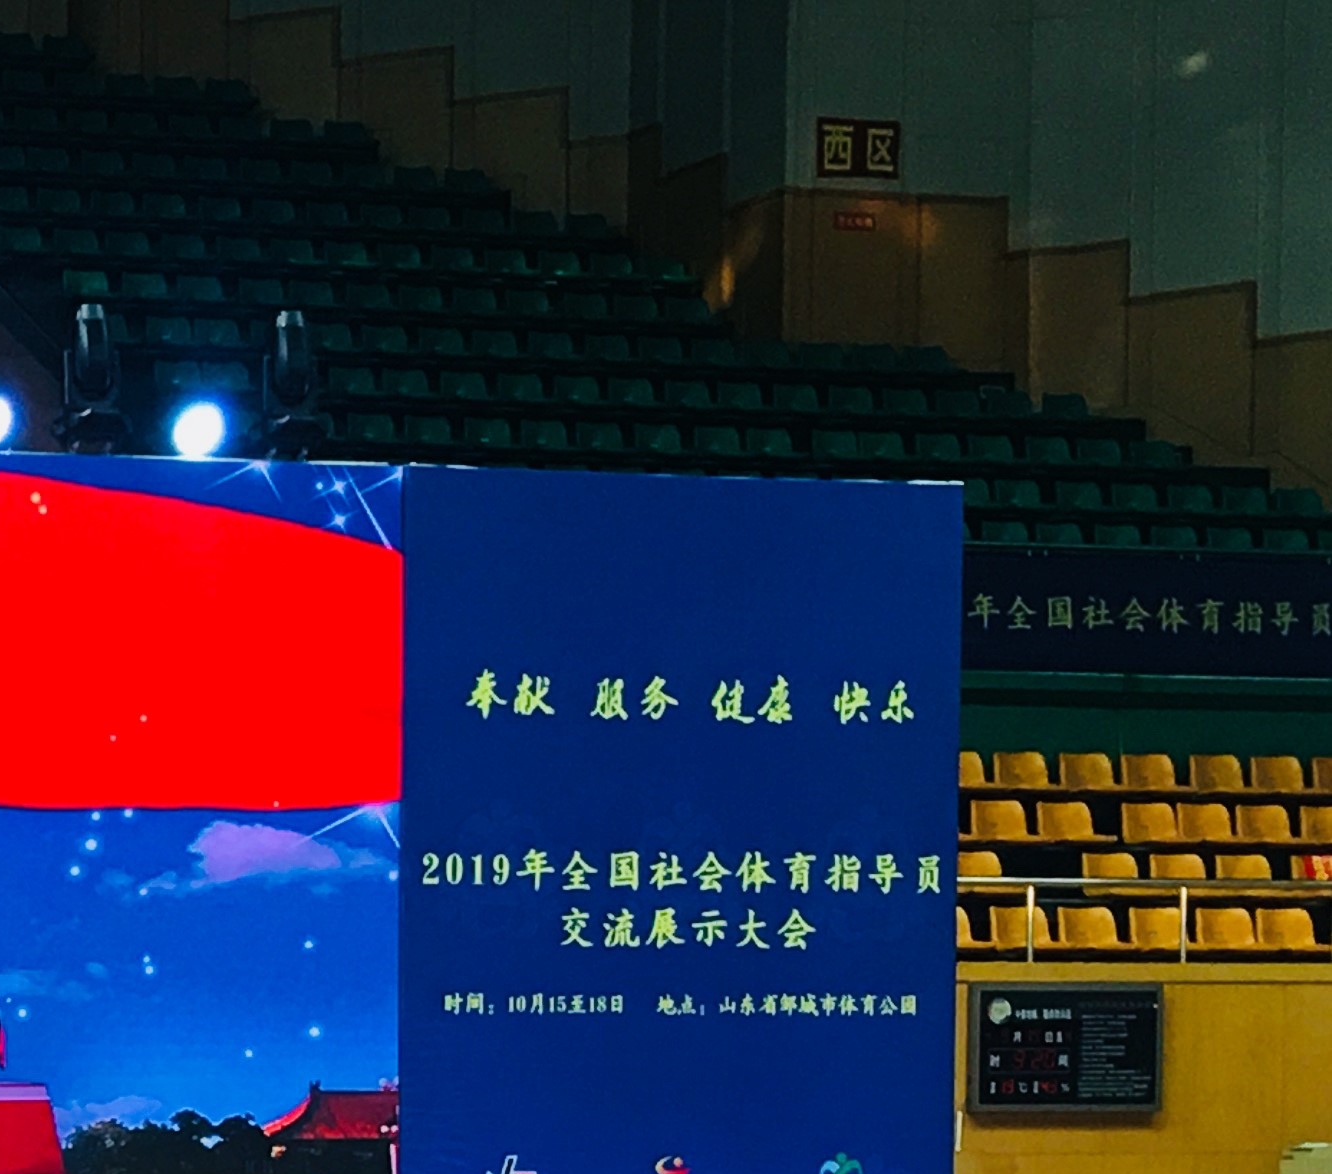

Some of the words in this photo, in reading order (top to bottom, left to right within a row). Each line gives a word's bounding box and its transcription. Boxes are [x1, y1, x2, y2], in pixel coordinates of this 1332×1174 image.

[822, 124, 894, 172] 西区
[967, 592, 1332, 636] 年全国社会体育指导员
[466, 667, 556, 720] 奉献
[590, 675, 679, 721] 服务
[711, 674, 794, 725] 健康
[833, 679, 916, 725] 快乐
[422, 847, 942, 895] 2019年全国社会体育指导员
[560, 906, 817, 951] 交流展示大会
